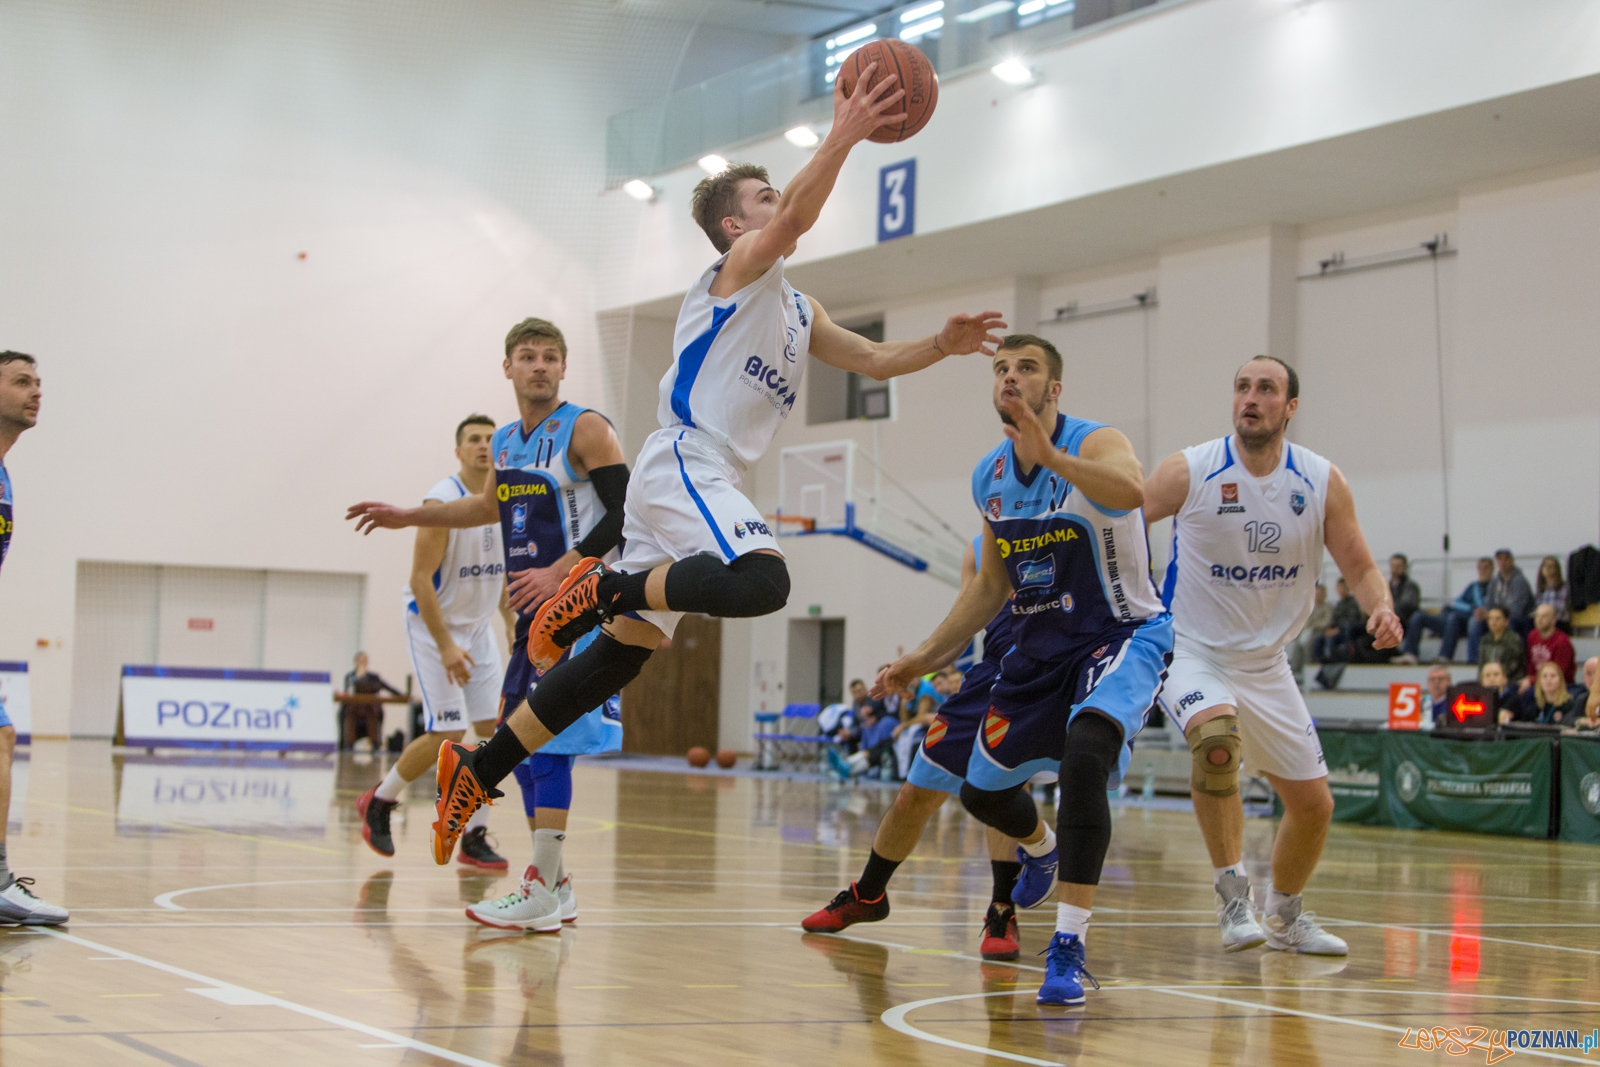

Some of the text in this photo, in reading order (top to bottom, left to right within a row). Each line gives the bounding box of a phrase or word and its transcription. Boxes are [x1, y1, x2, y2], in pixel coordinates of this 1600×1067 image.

[883, 167, 907, 232] 3
[535, 437, 554, 468] 11
[510, 483, 547, 497] ZETKAMA
[1012, 527, 1079, 553] ZETKAMA
[1244, 520, 1281, 554] 12
[459, 563, 505, 578] BIOFAR
[157, 700, 293, 729] POZnan
[1179, 691, 1204, 711] PBG
[1393, 687, 1417, 718] 5
